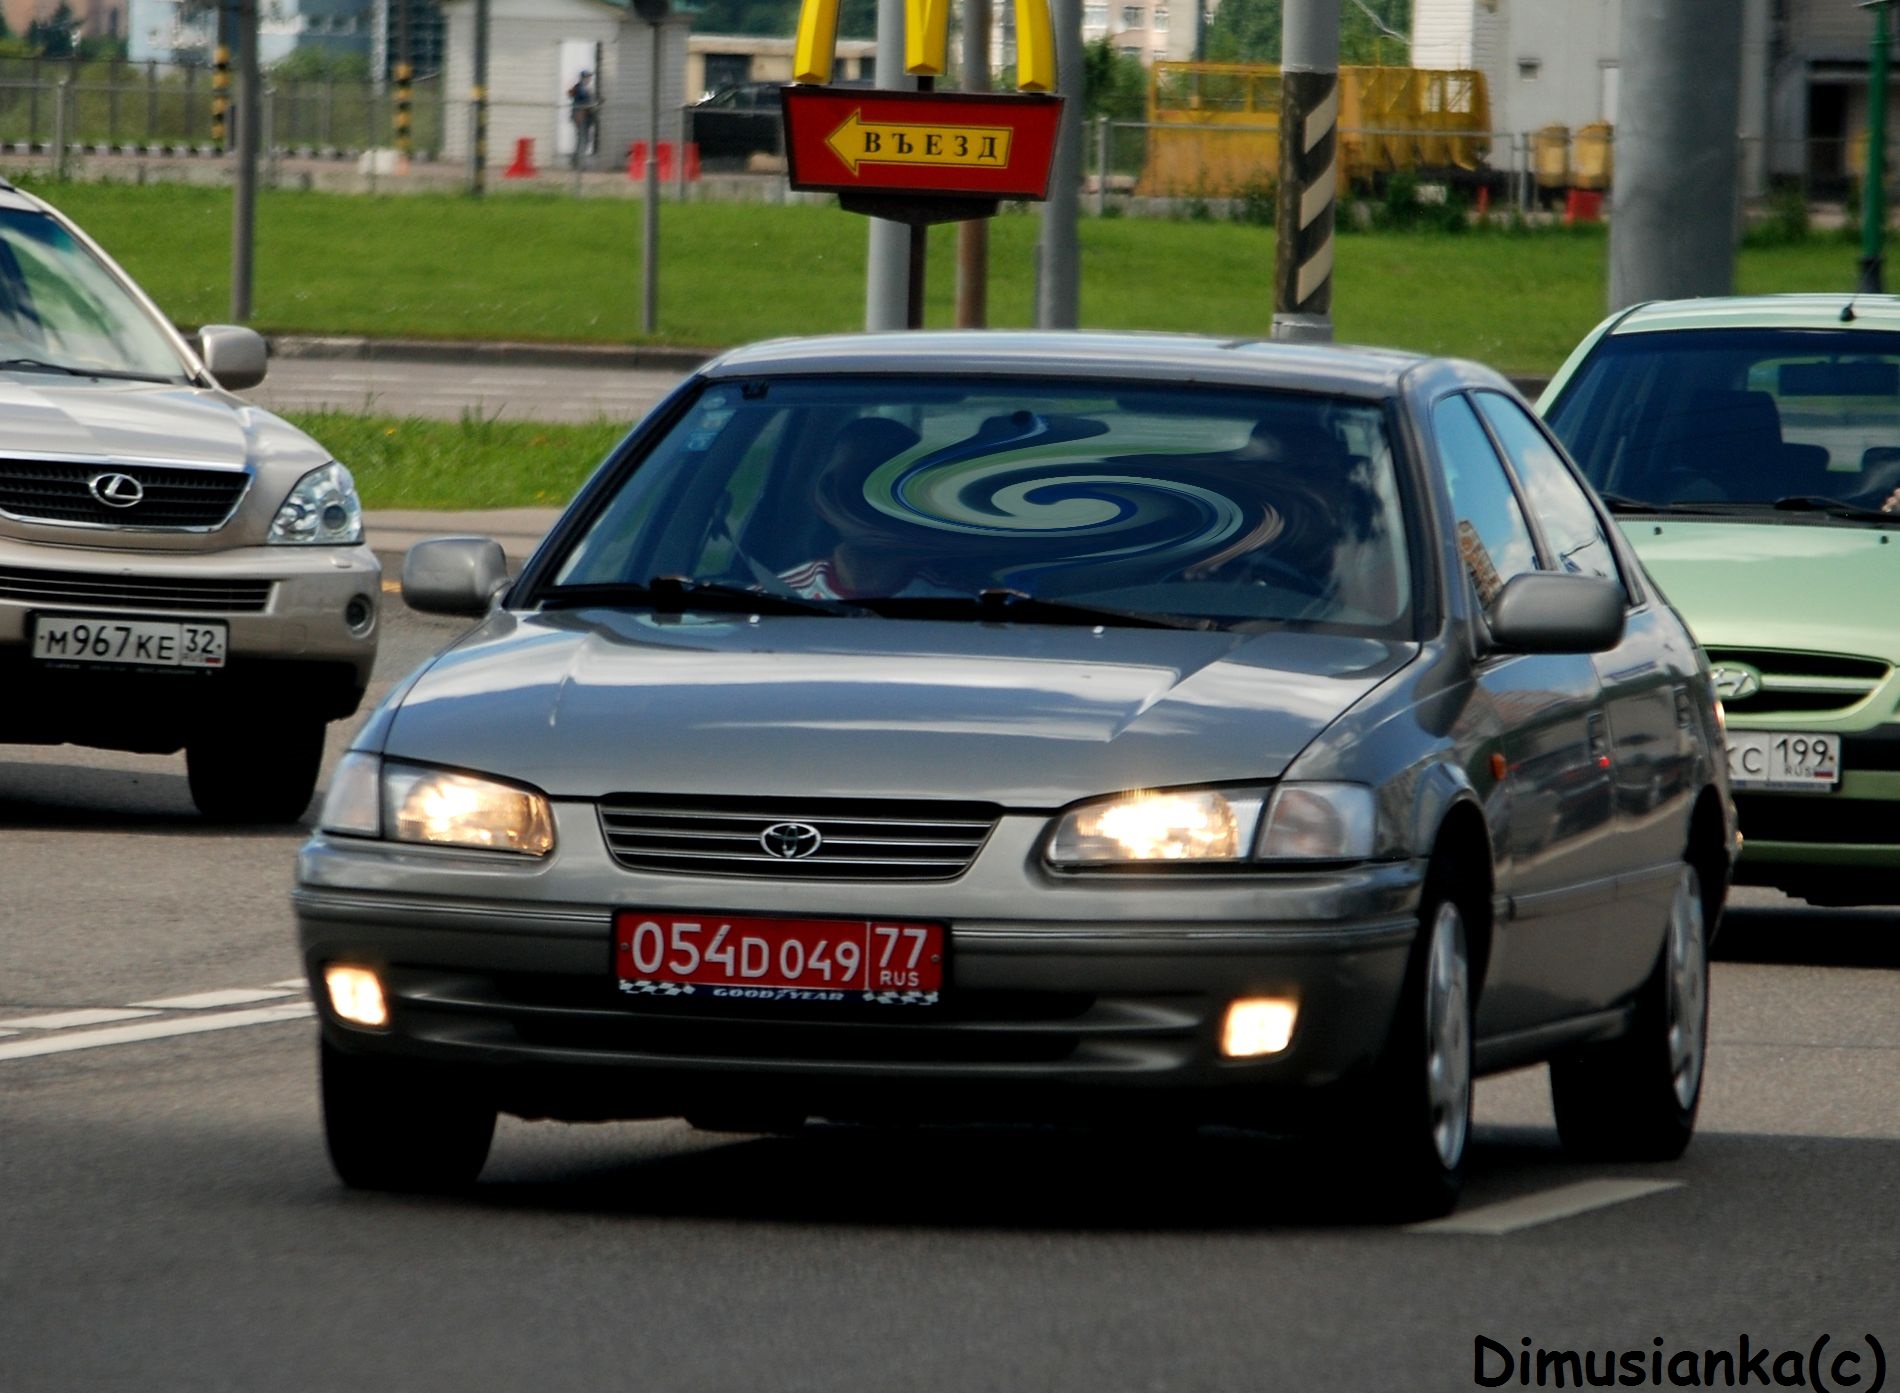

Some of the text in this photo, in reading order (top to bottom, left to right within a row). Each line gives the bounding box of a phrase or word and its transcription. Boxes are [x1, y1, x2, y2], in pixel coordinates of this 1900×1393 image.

[864, 131, 998, 161] ВЪЕЗД
[185, 628, 215, 654] 32
[1775, 738, 1828, 767] 199
[874, 927, 928, 970] 77
[880, 970, 920, 987] RUS
